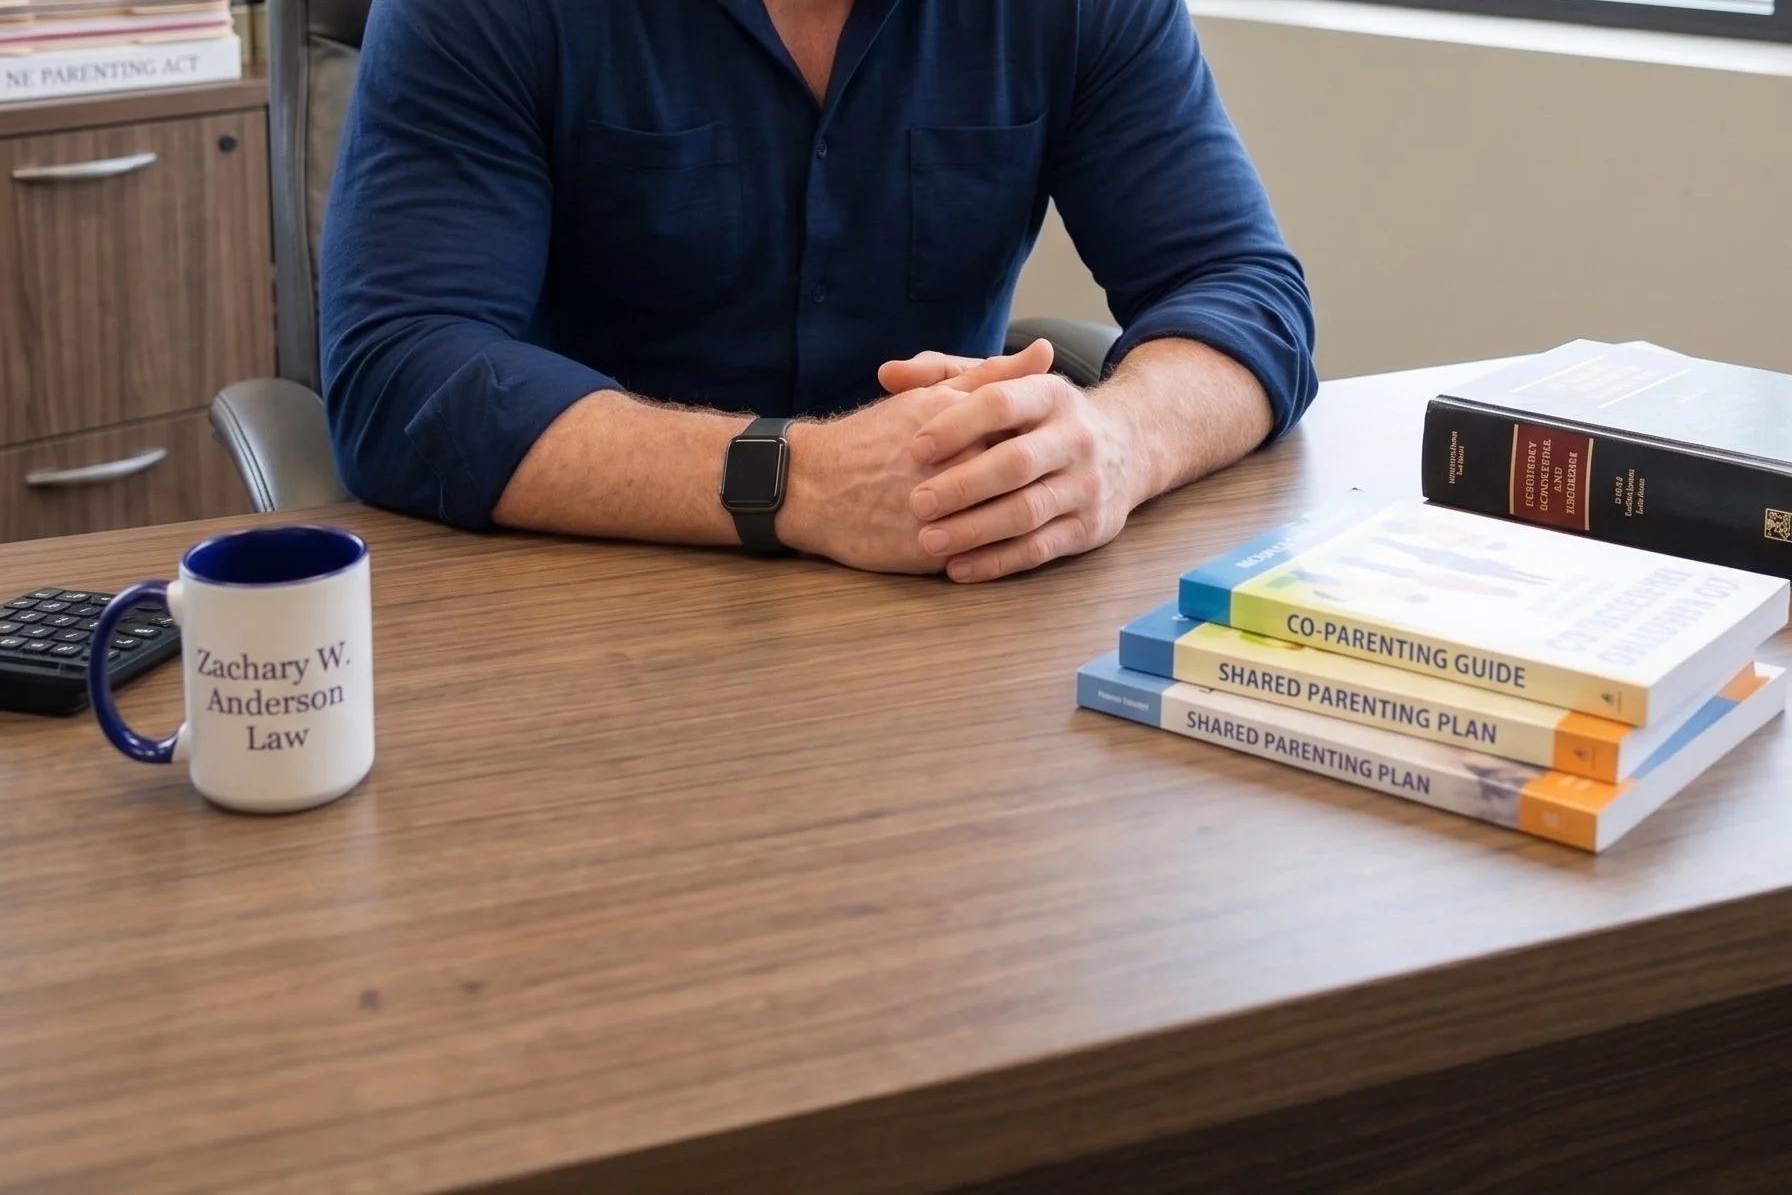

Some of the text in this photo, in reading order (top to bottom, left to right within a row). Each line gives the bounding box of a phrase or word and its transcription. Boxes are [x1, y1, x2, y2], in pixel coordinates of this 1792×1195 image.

[6, 55, 199, 90] NE PARENTING ACT
[197, 640, 351, 686] Zachary W.
[1287, 613, 1525, 689] CO-PARENTING GUIDE
[206, 685, 345, 716] Anderson
[1218, 662, 1498, 745] SHARED PARENTING PLAN
[246, 724, 311, 751] Law
[1186, 710, 1431, 795] SHARED PARENTING PLAN
